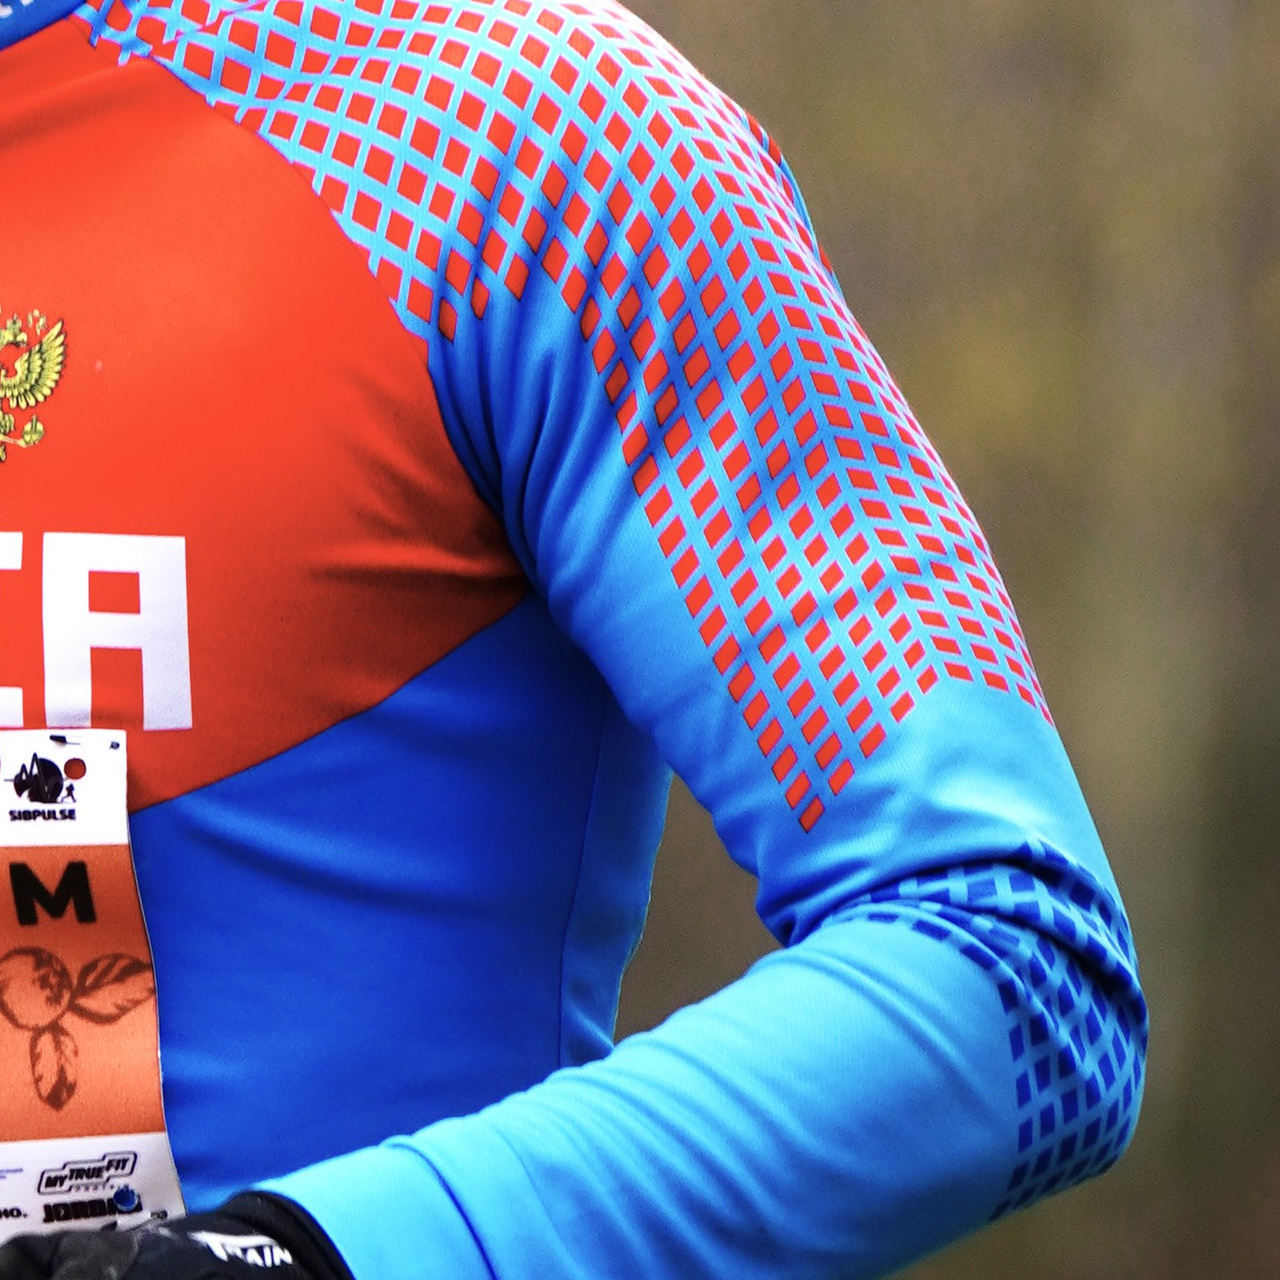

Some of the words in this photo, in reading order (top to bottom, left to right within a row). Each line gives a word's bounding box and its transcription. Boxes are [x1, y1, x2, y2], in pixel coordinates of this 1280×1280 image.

[9, 808, 76, 822] SIBPULSE
[44, 1174, 68, 1189] MY
[68, 1165, 105, 1181] TRUE
[104, 1157, 130, 1172] FIT
